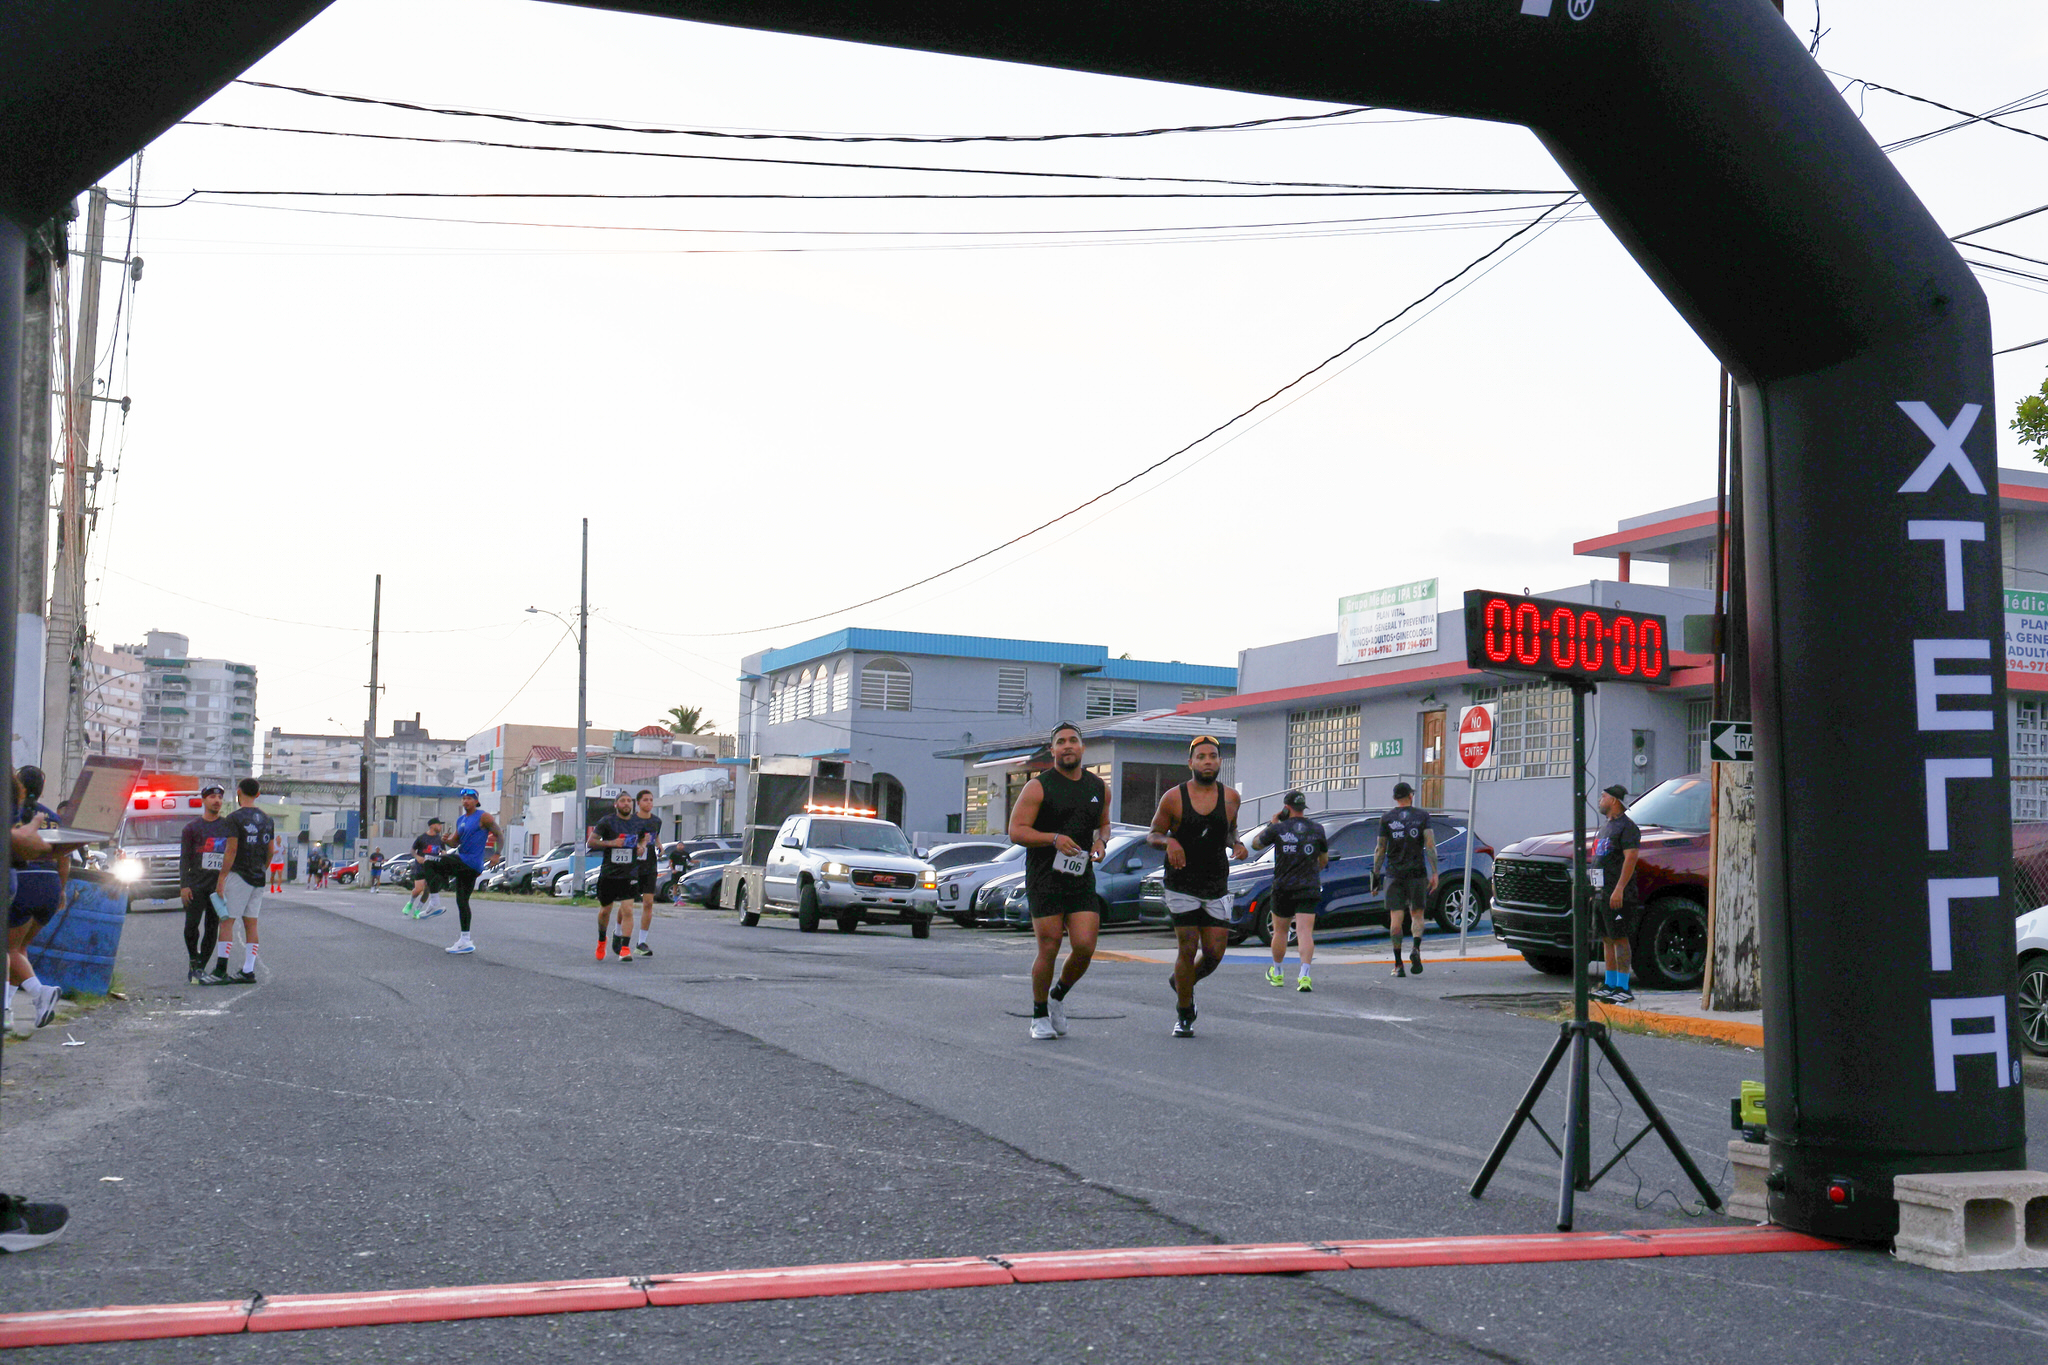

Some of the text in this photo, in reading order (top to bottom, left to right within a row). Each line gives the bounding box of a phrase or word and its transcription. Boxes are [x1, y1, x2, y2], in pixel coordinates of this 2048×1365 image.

[1346, 584, 1428, 612] Grupo Médico IPA 513
[1376, 607, 1406, 620] PLAN VITAL
[1350, 625, 1373, 637] MEDICINA
[1374, 621, 1397, 633] GENERAL
[1403, 614, 1435, 628] PREVENTIVA
[1485, 599, 1662, 678] 00:00:00
[1396, 641, 1406, 652] 787
[1471, 716, 1482, 729] NO
[1370, 740, 1401, 758] IPA 513
[1464, 745, 1484, 757] ENTRE
[1063, 858, 1082, 872] 106
[873, 874, 896, 883] GMC
